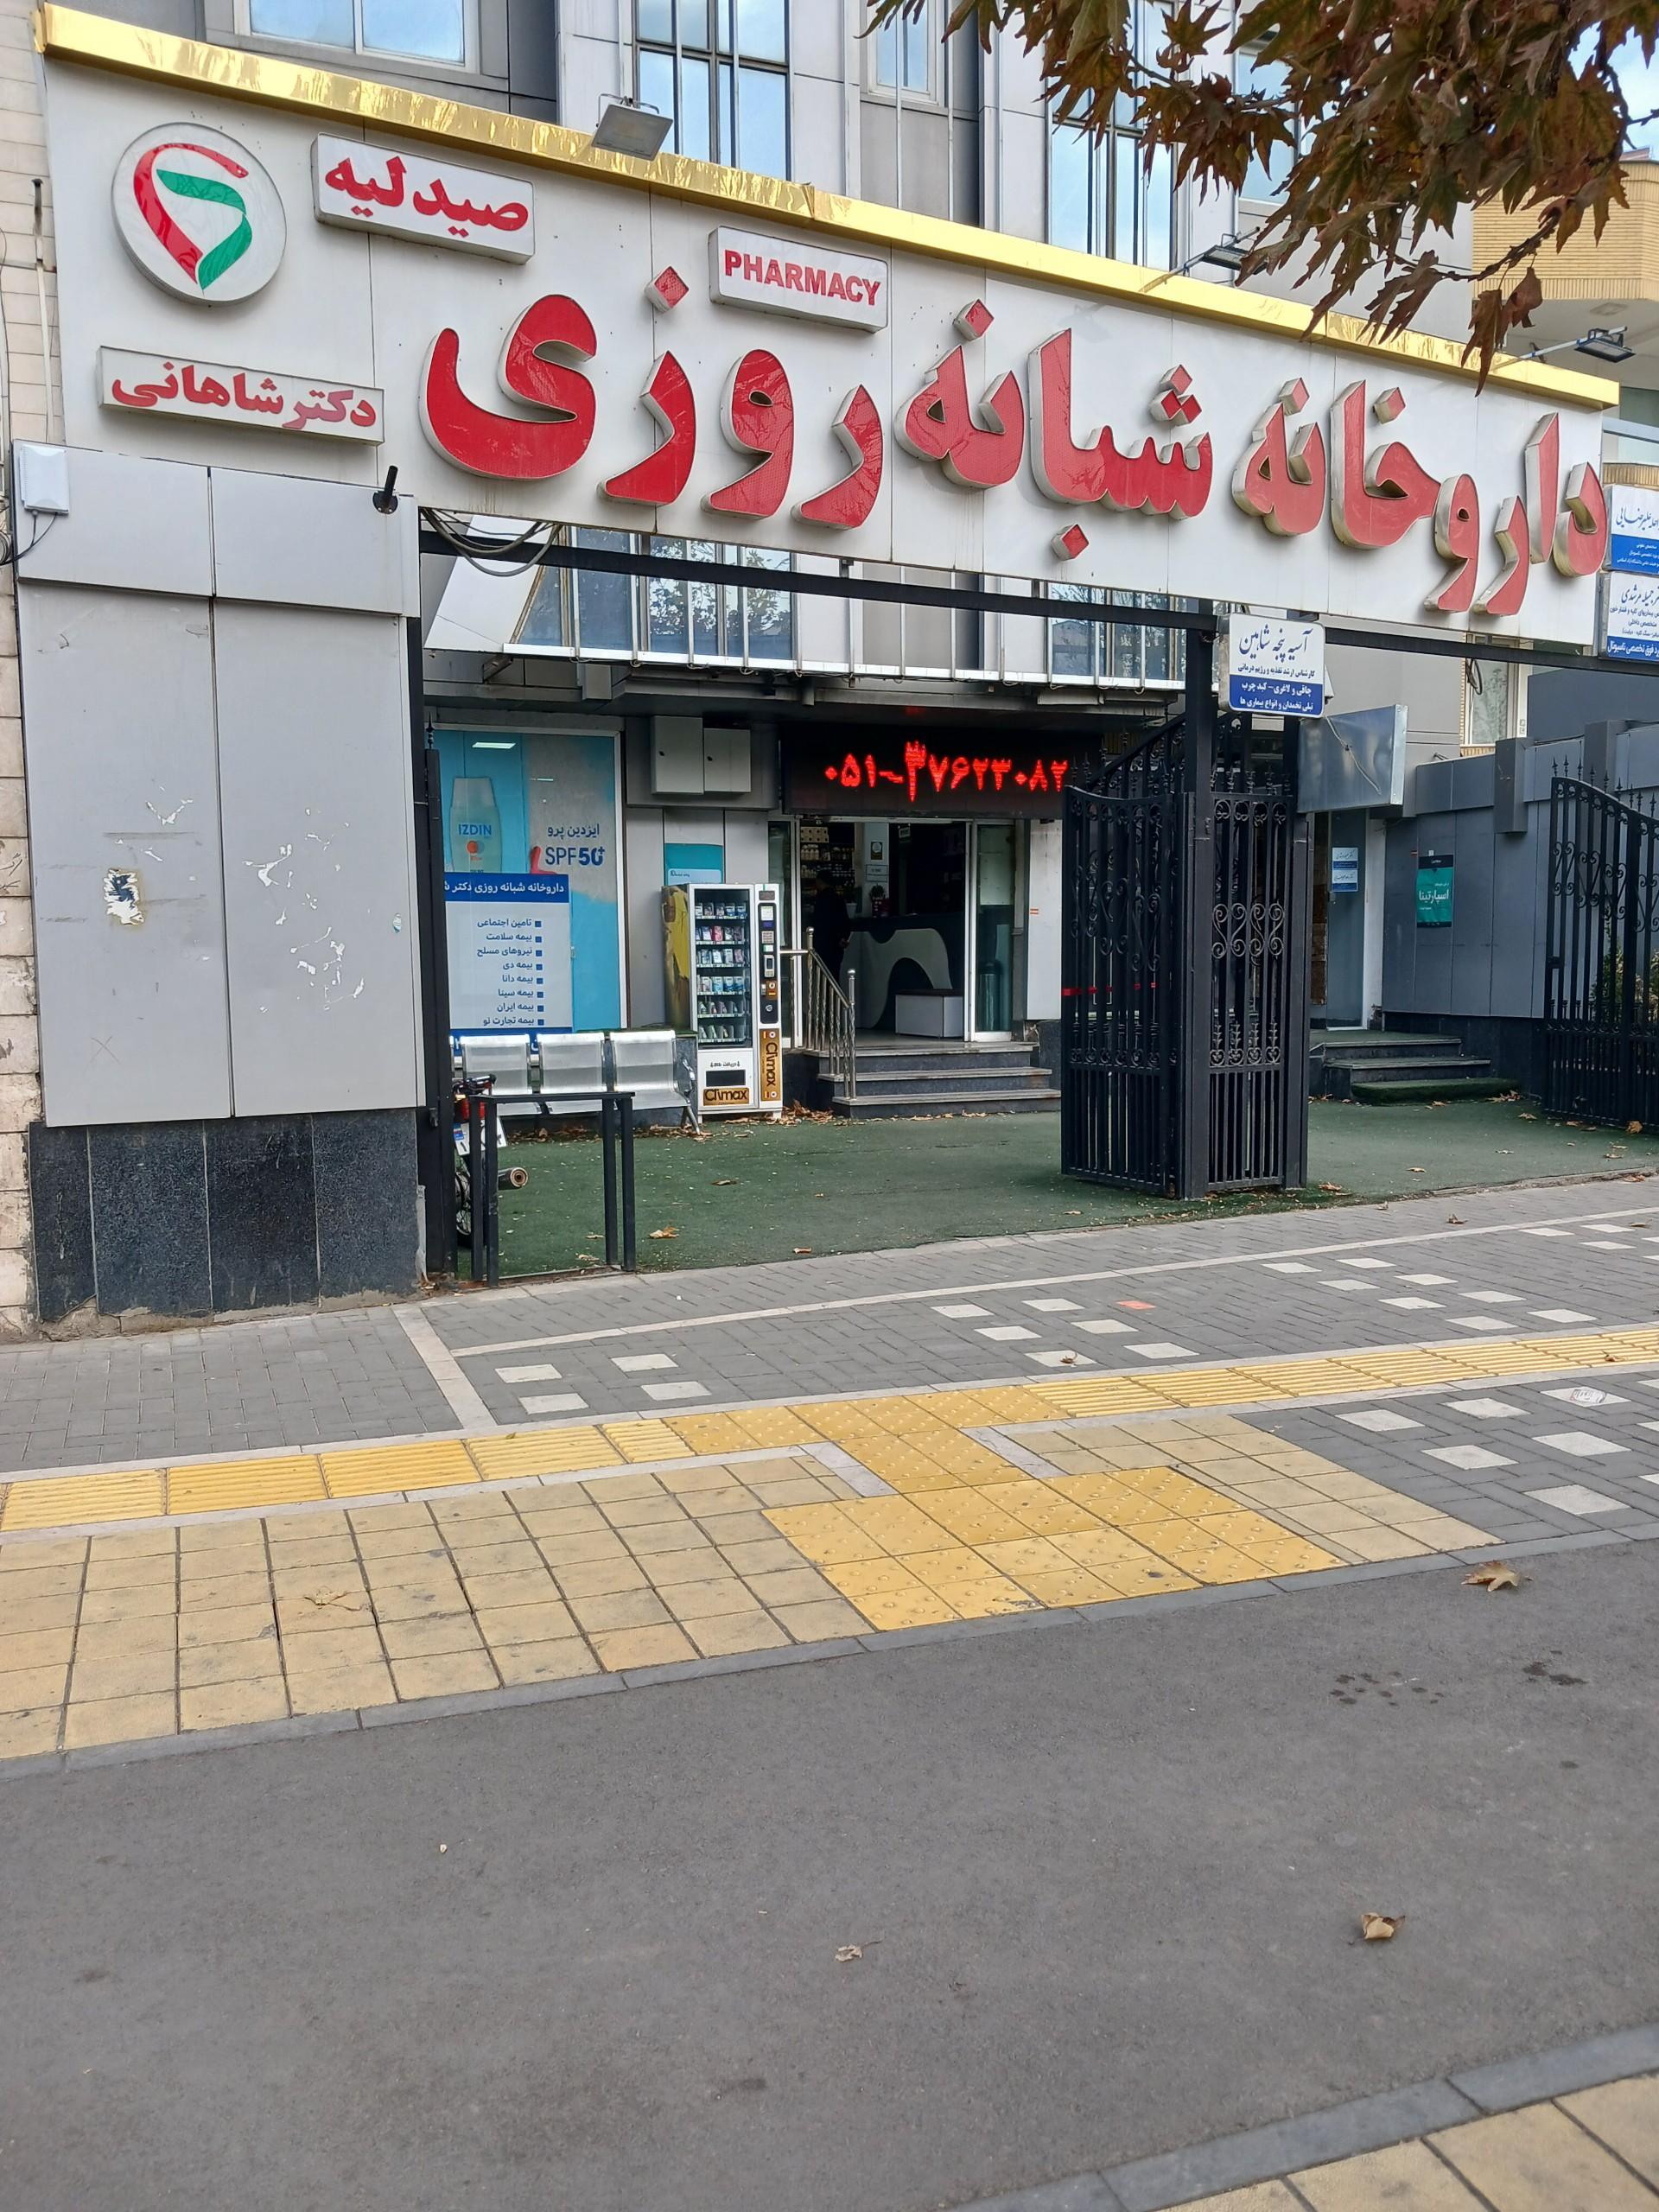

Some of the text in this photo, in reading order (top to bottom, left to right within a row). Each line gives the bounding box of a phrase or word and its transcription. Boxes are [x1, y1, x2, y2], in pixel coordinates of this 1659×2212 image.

[325, 156, 529, 238] صیدلیه
[723, 249, 881, 306] PHARMACY
[111, 361, 377, 430] دکتر شاهانی
[418, 266, 1608, 615] داروخانه شبانه روزی
[1239, 624, 1313, 663] آسیه پنجه شاهین
[1626, 644, 1645, 655] تخصصی
[1295, 670, 1315, 678] کارشناس
[1241, 682, 1256, 692] چرب
[1256, 682, 1268, 692] کبد
[1296, 684, 1312, 697] چاقی
[458, 824, 493, 836] IZDIN
[547, 823, 600, 840] ایزدین پرو
[451, 881, 472, 893] دکتر
[474, 883, 499, 893] روزی
[499, 881, 525, 894] شبانه
[527, 882, 564, 894] داروخانه
[477, 918, 532, 928] تامین اجتماعی
[516, 934, 532, 943] بیمه
[477, 947, 532, 957] نیروهای مسلح
[503, 962, 532, 970] بیمه دی
[498, 988, 515, 998] سینا
[497, 1002, 534, 1012] بیمه ایران
[493, 1016, 516, 1026] تجارت
[766, 1042, 779, 1087] Climax
[704, 1088, 747, 1101] Climax
